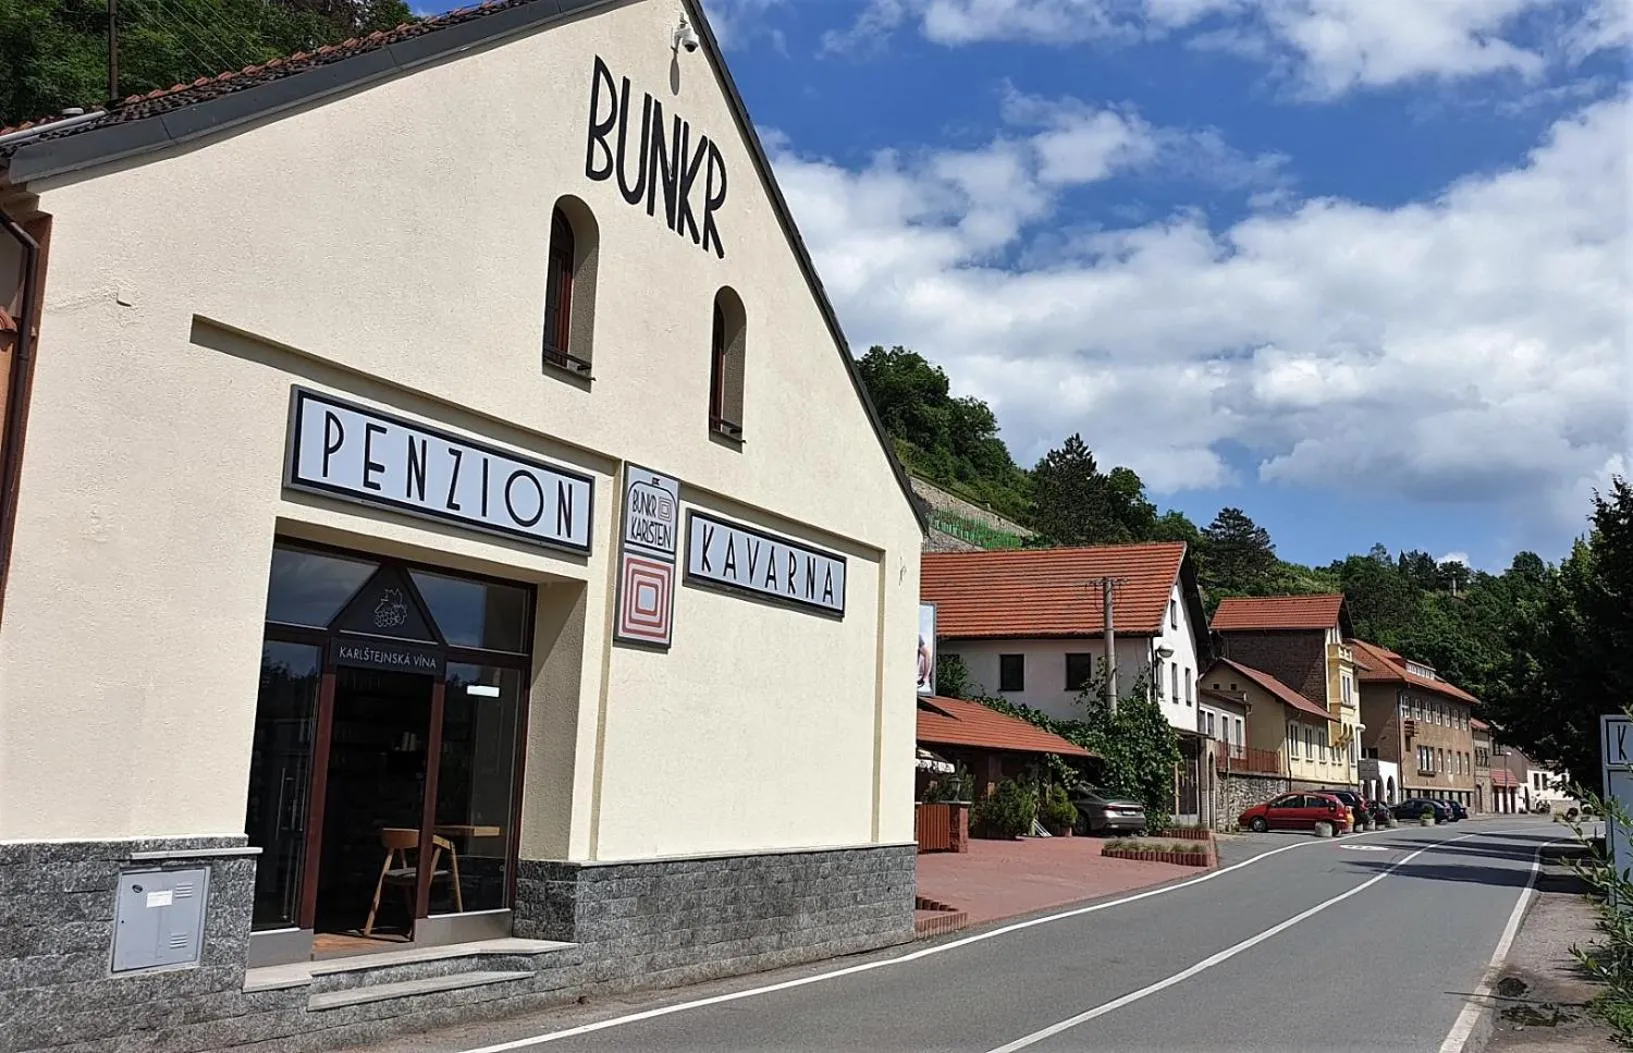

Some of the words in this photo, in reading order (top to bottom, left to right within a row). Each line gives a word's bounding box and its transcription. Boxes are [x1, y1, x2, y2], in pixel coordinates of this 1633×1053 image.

[585, 54, 727, 259] BUNKR
[322, 410, 573, 539] PENZION
[632, 488, 657, 518] BUNKR
[701, 523, 834, 605] KAVARNA
